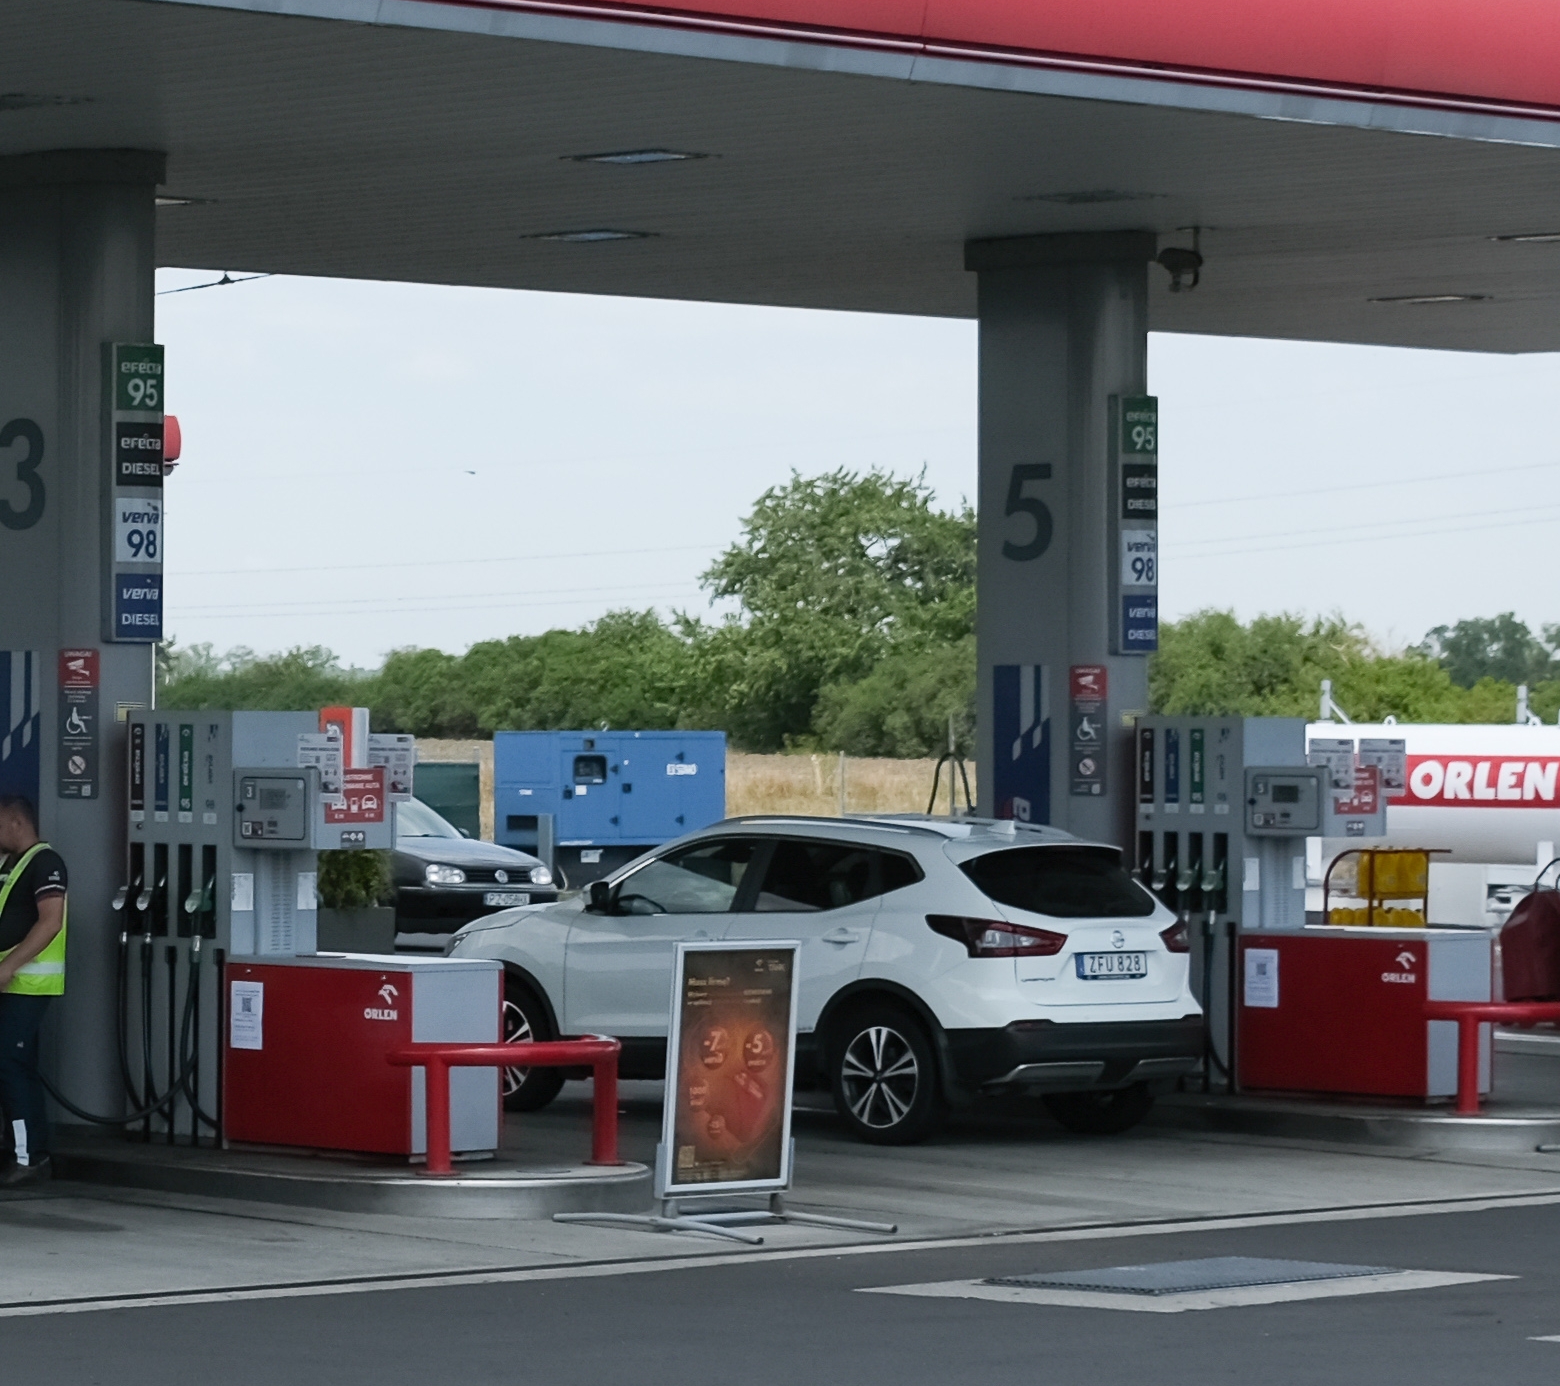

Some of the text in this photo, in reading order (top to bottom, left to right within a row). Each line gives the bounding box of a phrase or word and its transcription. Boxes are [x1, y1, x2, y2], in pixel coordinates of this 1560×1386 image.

[120, 361, 161, 375] efecta
[126, 377, 158, 408] 95
[120, 437, 161, 451] efecta
[1132, 425, 1155, 451] 95
[121, 462, 161, 476] DIESEL
[121, 511, 159, 525] verva
[1001, 463, 1054, 562] 5
[126, 528, 157, 559] 98
[1131, 557, 1155, 582] 98
[122, 587, 159, 600] verva
[121, 613, 160, 626] DIESEL
[1408, 759, 1559, 803] ORLEN
[246, 786, 253, 798] 3
[1089, 954, 1141, 974] ZFU 828
[1381, 972, 1416, 984] ORLEN
[363, 1007, 398, 1021] ORLEN
